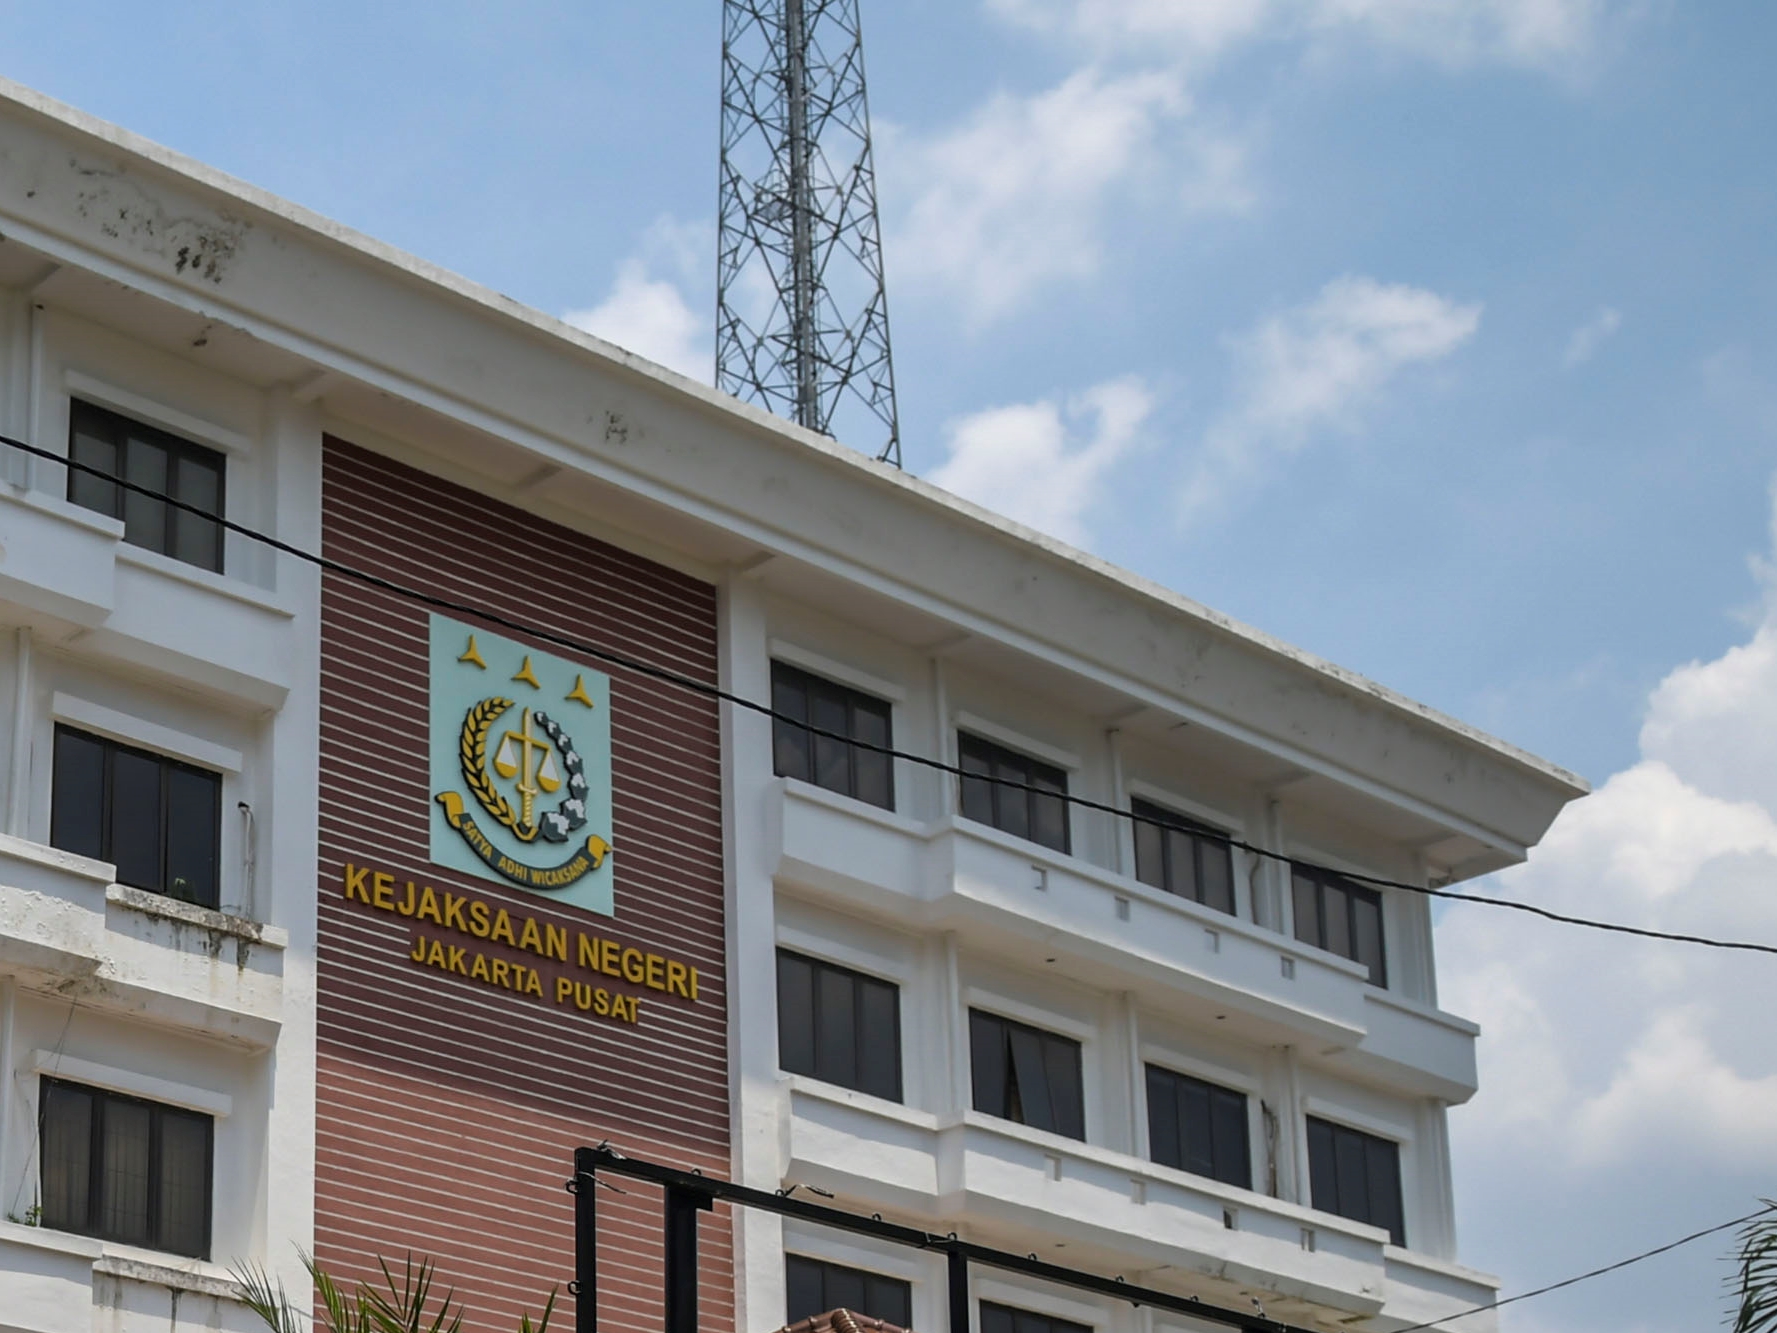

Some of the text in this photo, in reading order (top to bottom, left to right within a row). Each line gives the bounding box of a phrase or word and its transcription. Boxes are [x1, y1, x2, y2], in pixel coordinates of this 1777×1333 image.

[462, 821, 590, 886] SATYA ADHI WICAKSANA
[343, 863, 699, 1001] KEJAKSAAN NEGERI
[410, 936, 642, 1025] JAKARTA PUSAT
